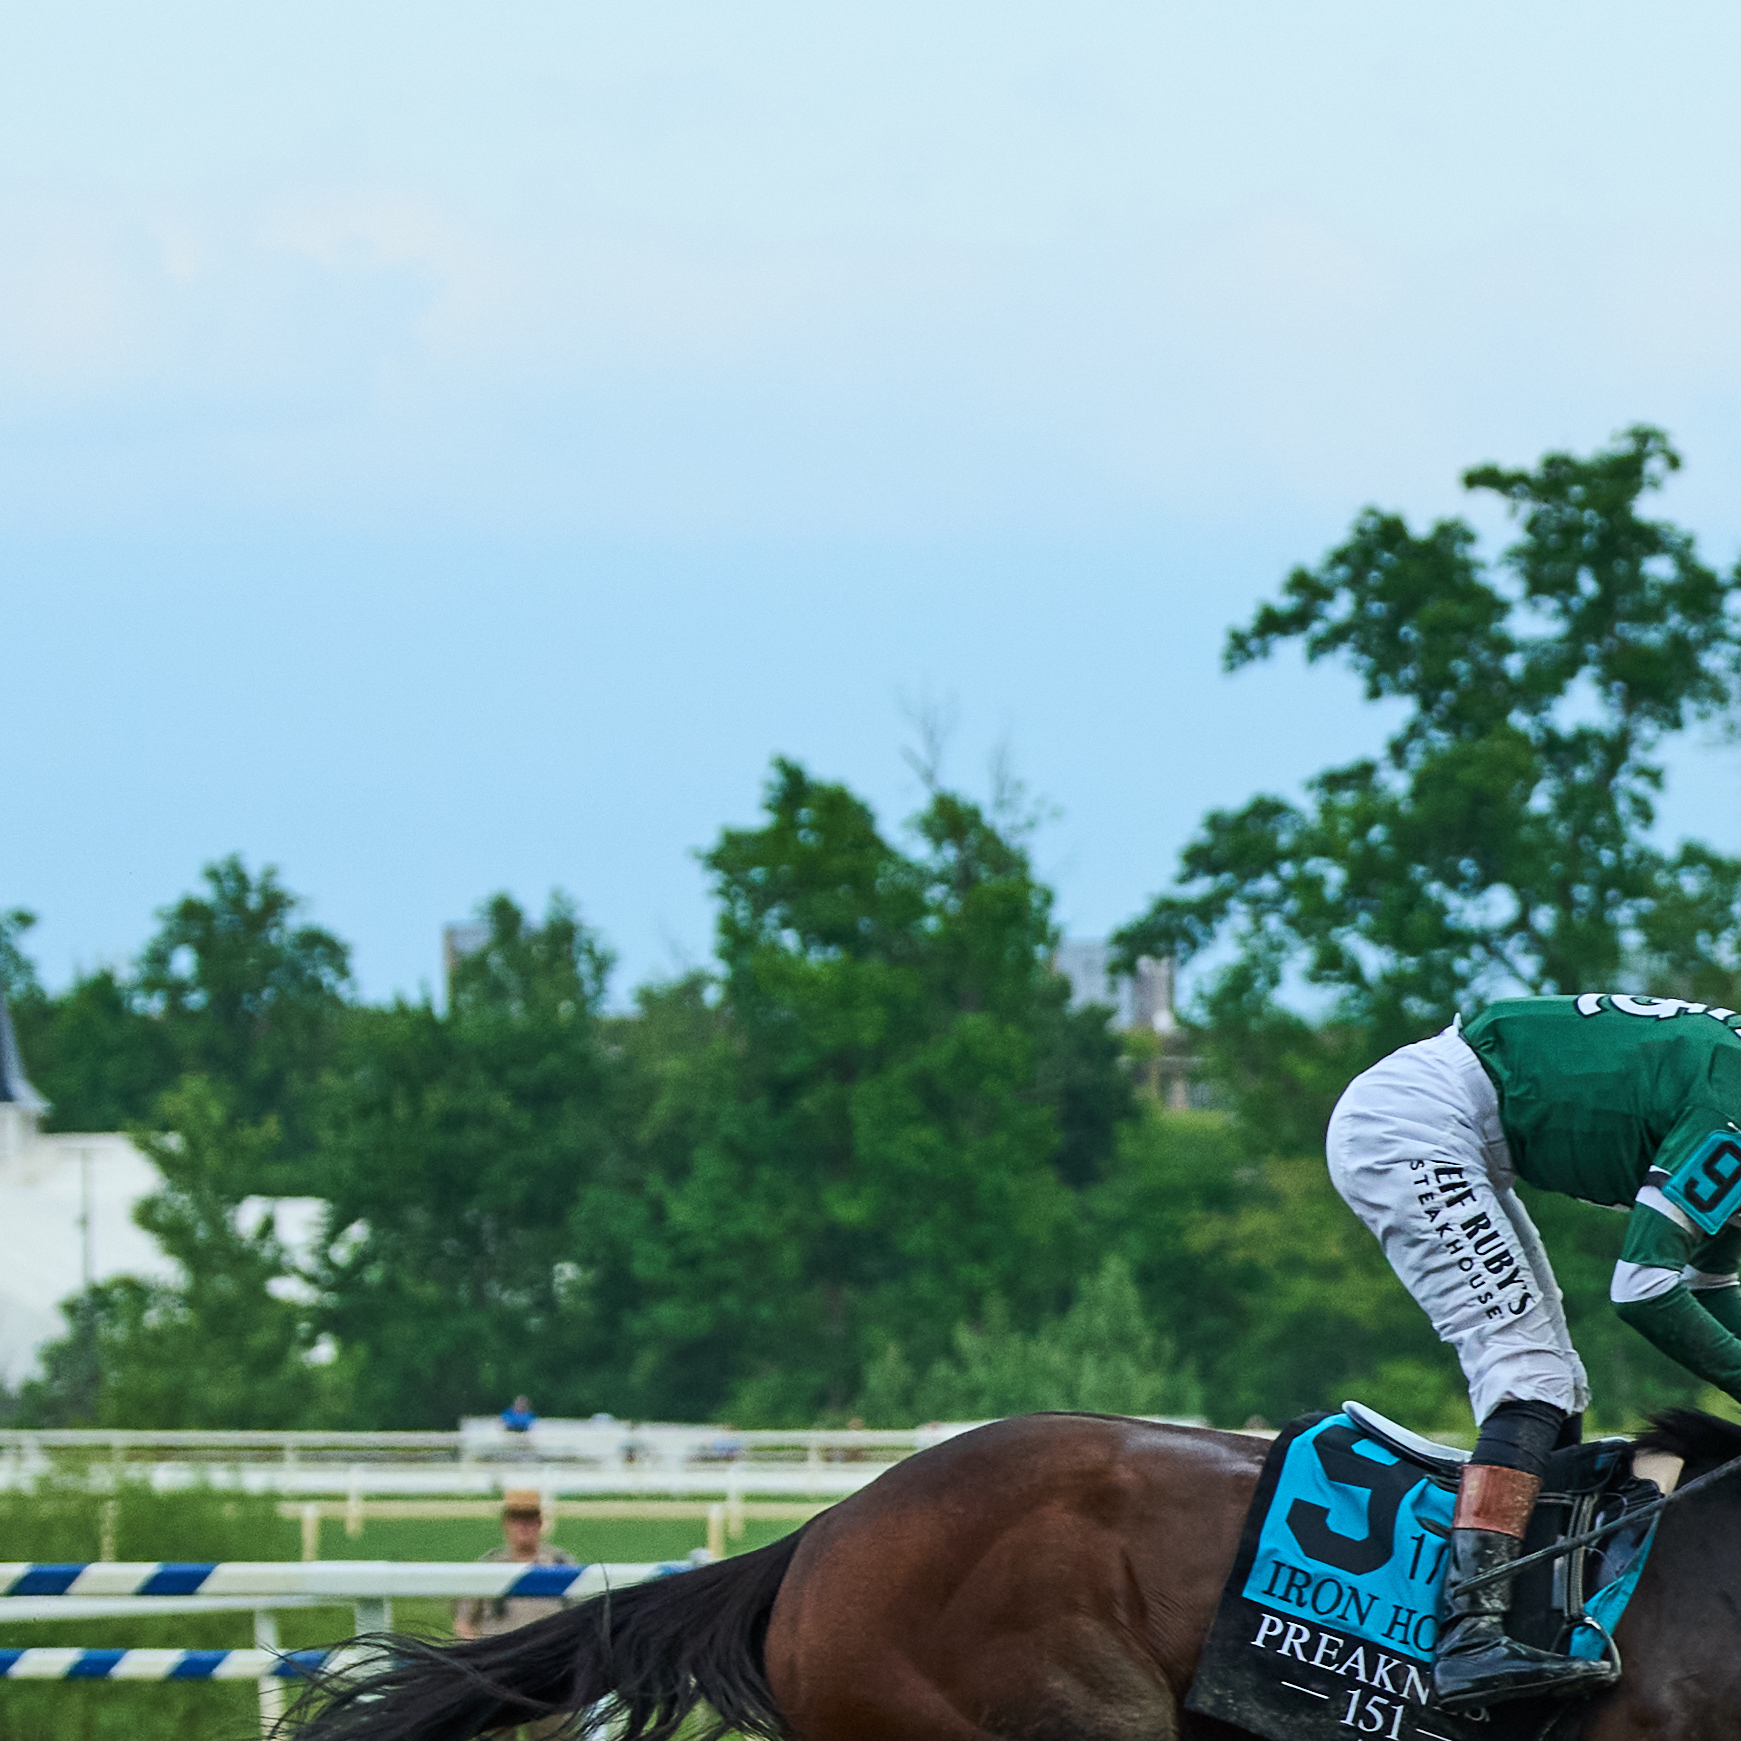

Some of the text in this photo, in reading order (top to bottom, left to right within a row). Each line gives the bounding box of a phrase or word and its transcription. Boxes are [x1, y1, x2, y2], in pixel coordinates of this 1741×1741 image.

[1410, 1159, 1503, 1319] STEAKHOUSE
[1432, 1159, 1536, 1315] EFF RUBY'S
[1285, 1424, 1424, 1576] 9
[1251, 1612, 1490, 1722] PREAKN
[1262, 1560, 1439, 1652] IRON HO
[1340, 1688, 1404, 1741] 151
